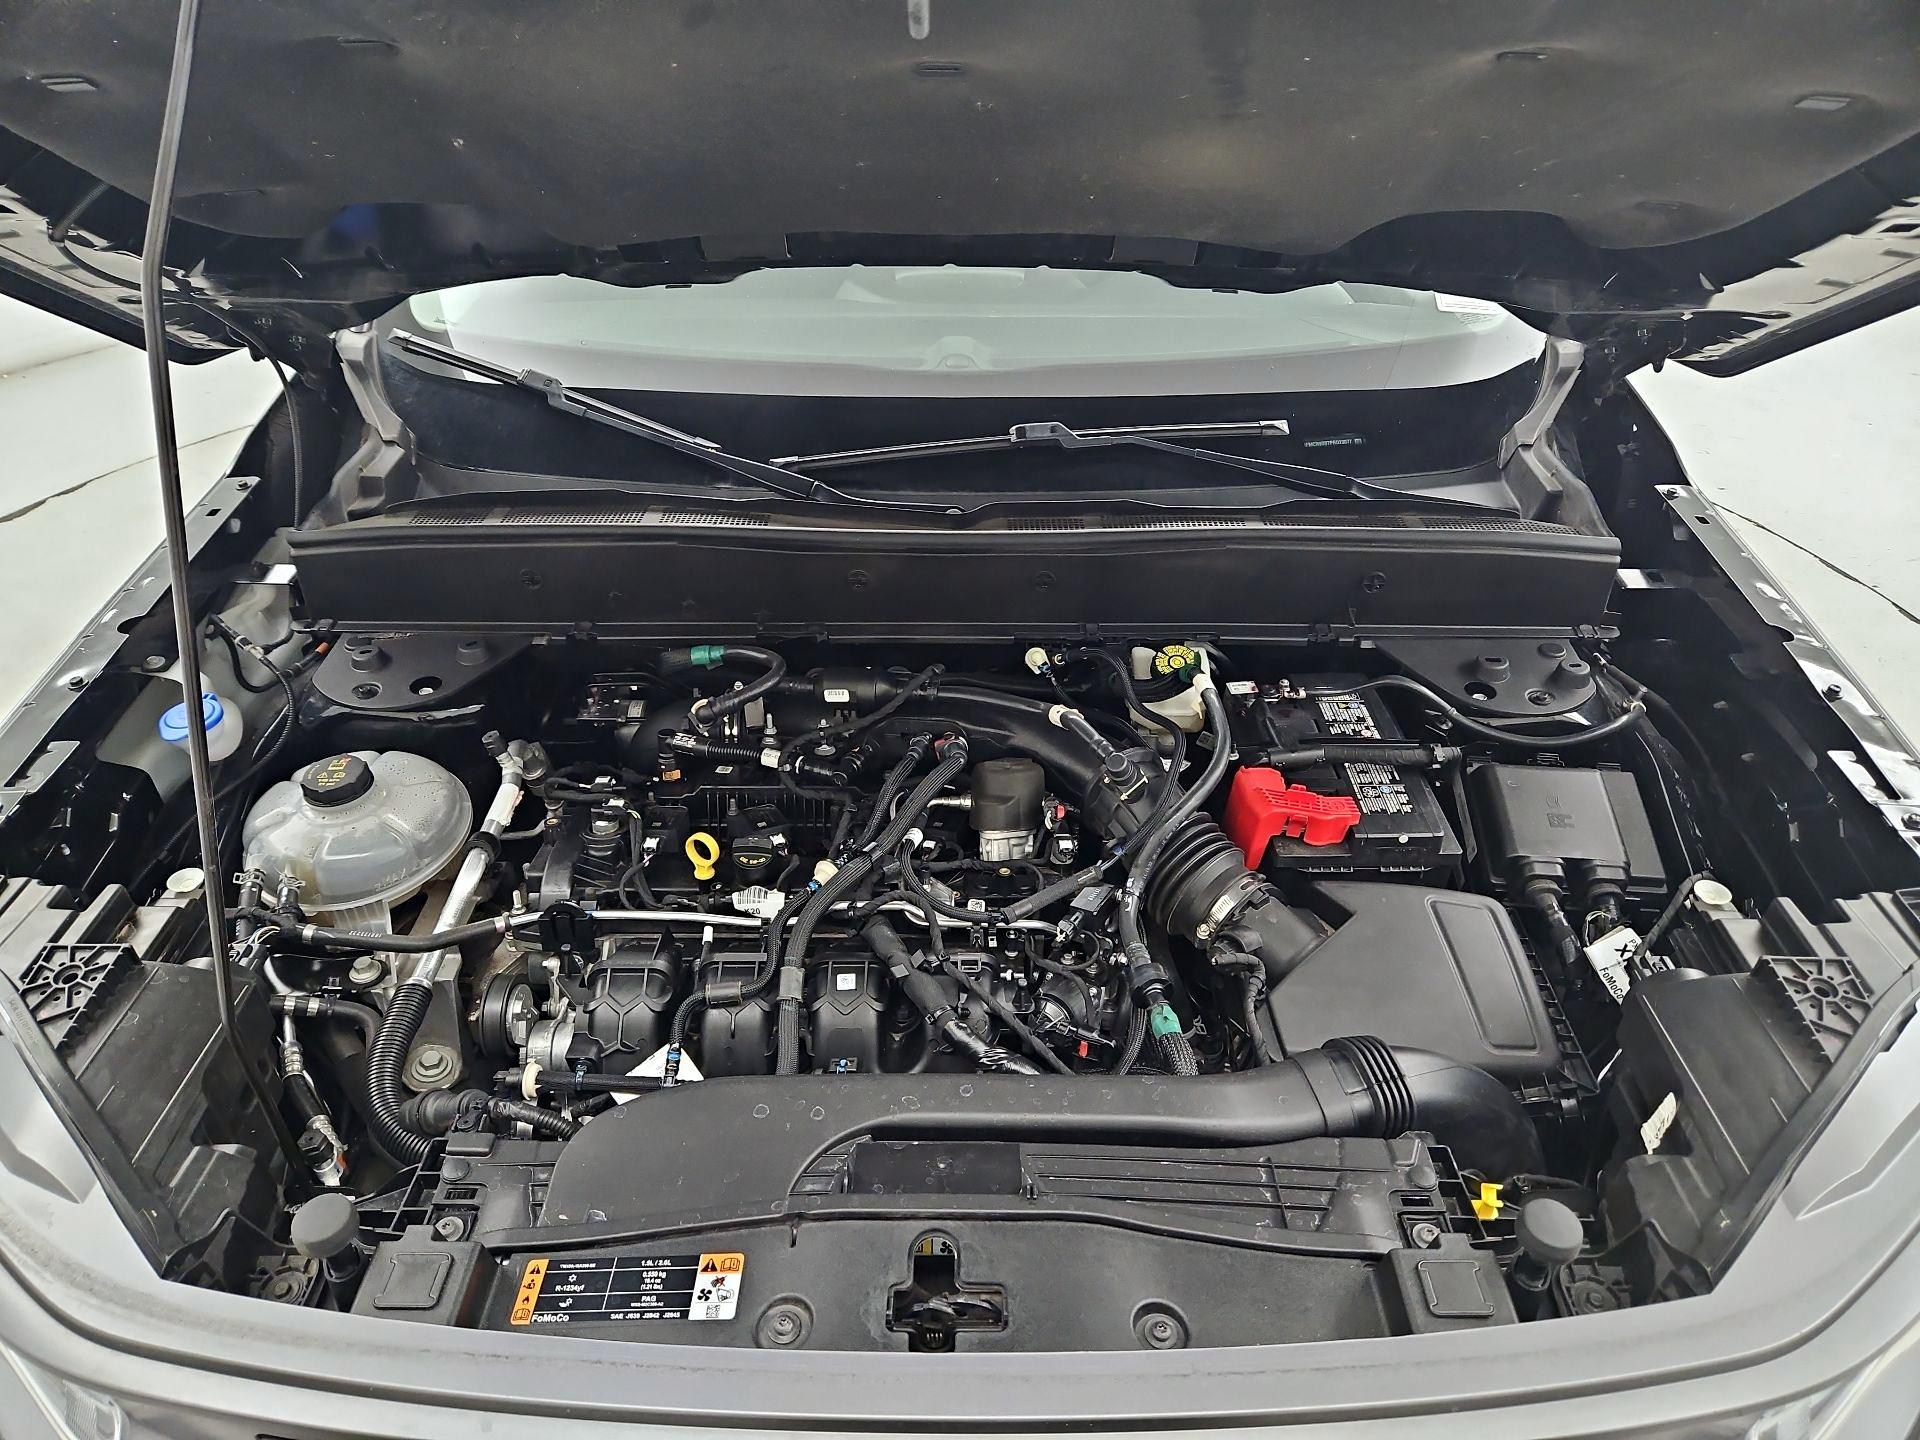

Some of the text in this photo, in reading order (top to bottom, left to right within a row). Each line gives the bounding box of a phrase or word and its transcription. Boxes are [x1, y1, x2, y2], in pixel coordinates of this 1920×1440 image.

[1599, 967, 1624, 1000] FoMoCo
[555, 1284, 585, 1293] R-1234yf
[531, 1314, 570, 1323] FoMoCo
